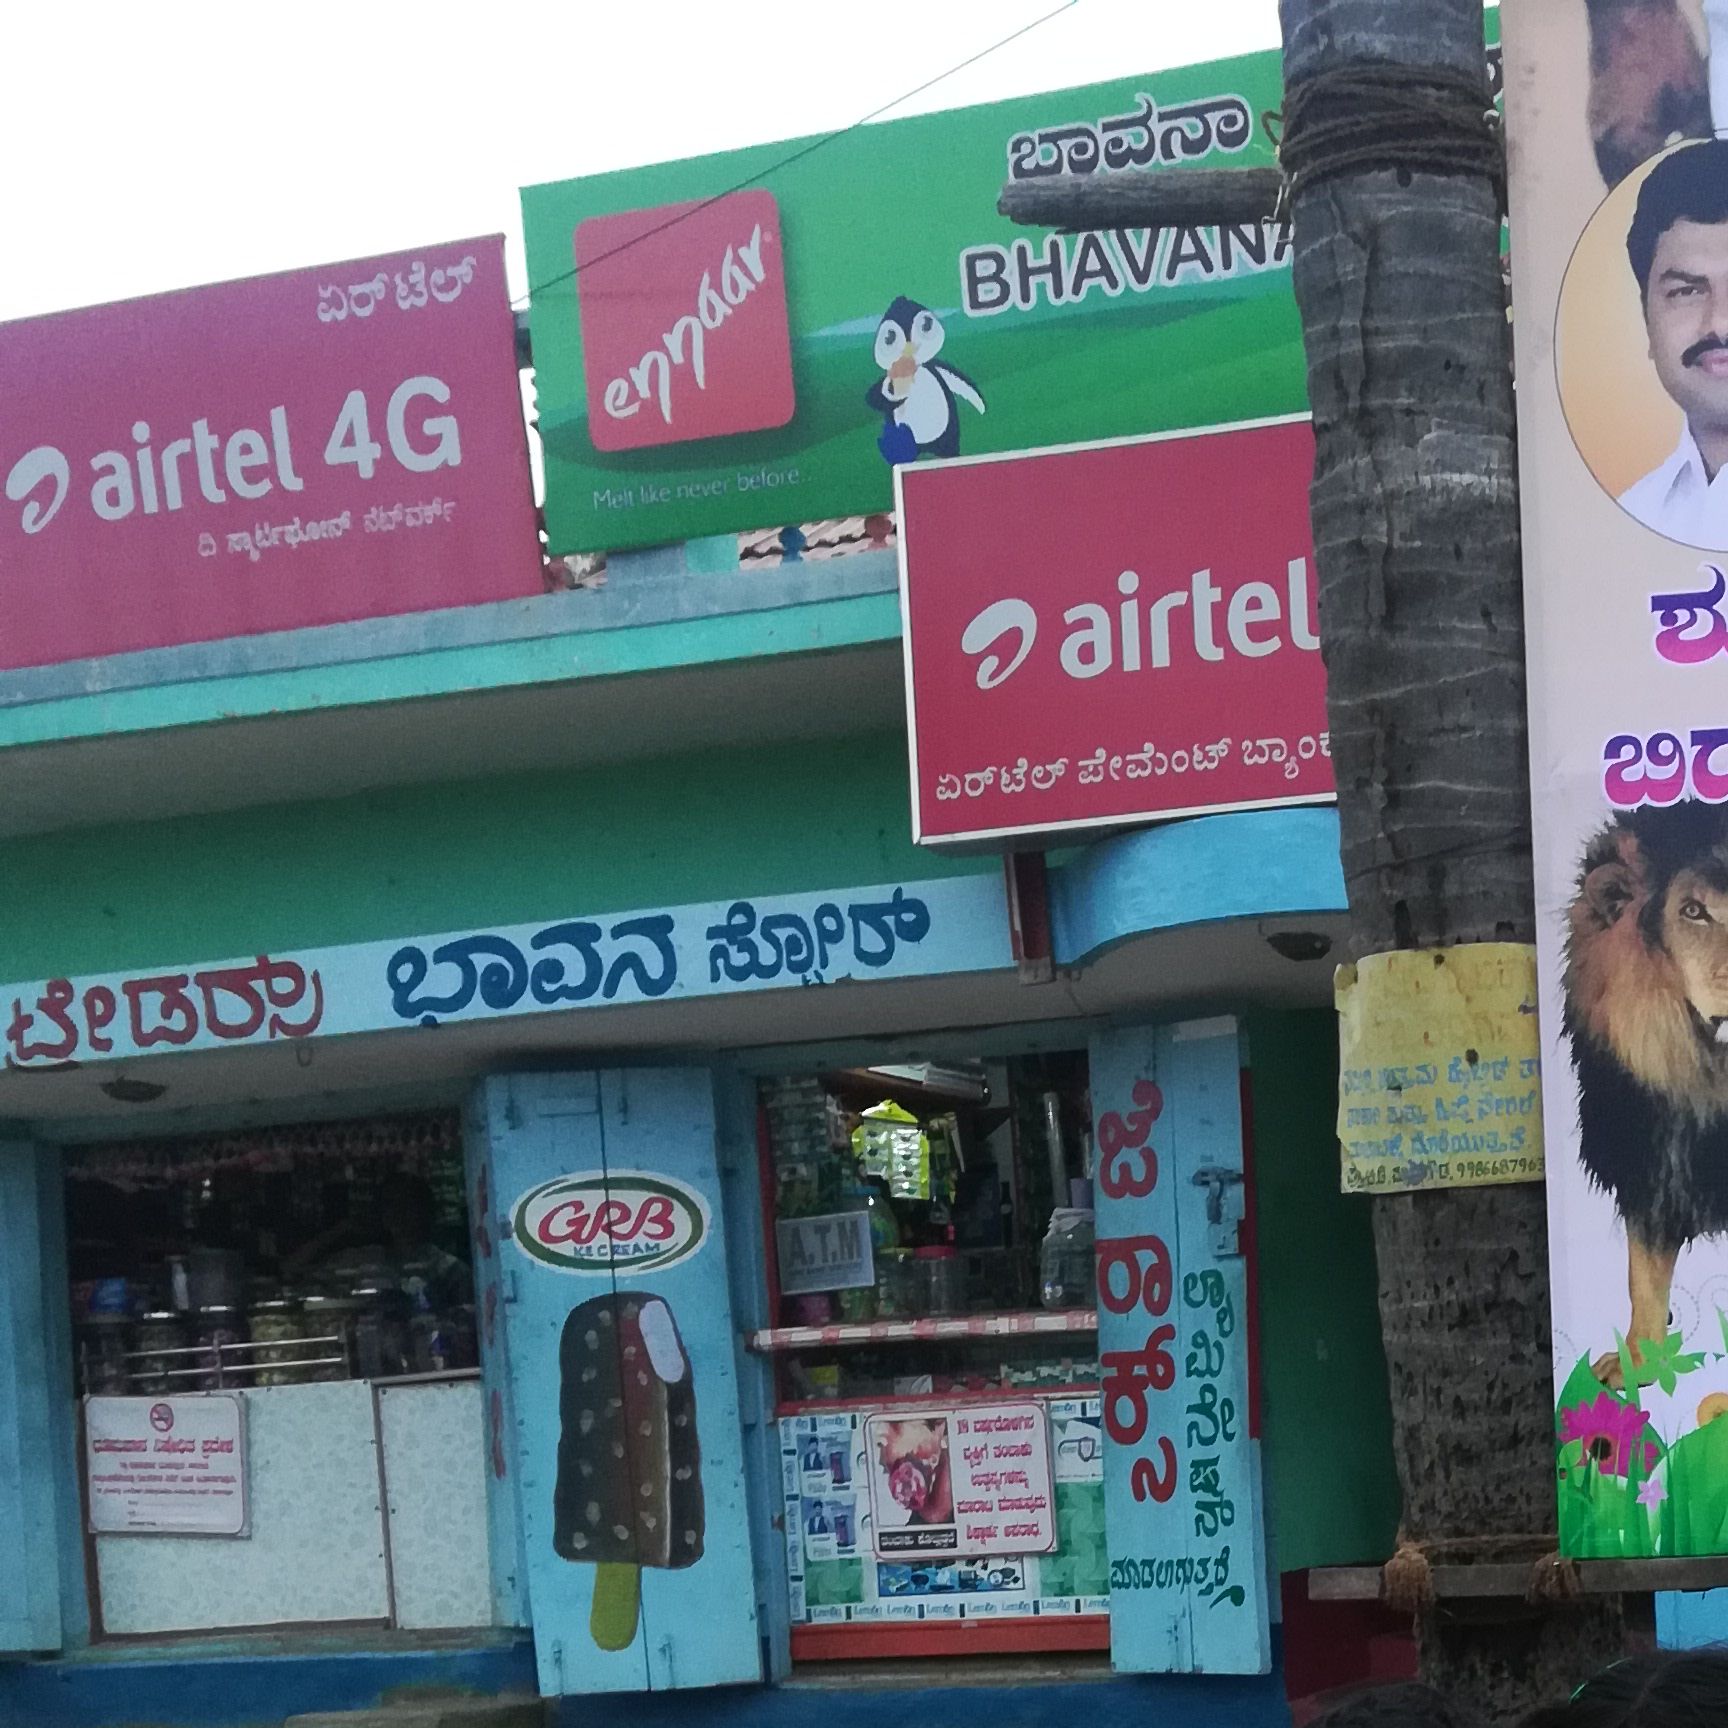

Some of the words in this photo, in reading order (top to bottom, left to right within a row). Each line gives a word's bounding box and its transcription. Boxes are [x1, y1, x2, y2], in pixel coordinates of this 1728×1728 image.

[90, 406, 303, 521] airtel
[324, 376, 462, 479] 4G
[1059, 557, 1320, 679] airtel
[538, 1196, 675, 1245] GRB
[598, 1242, 660, 1257] CREAM
